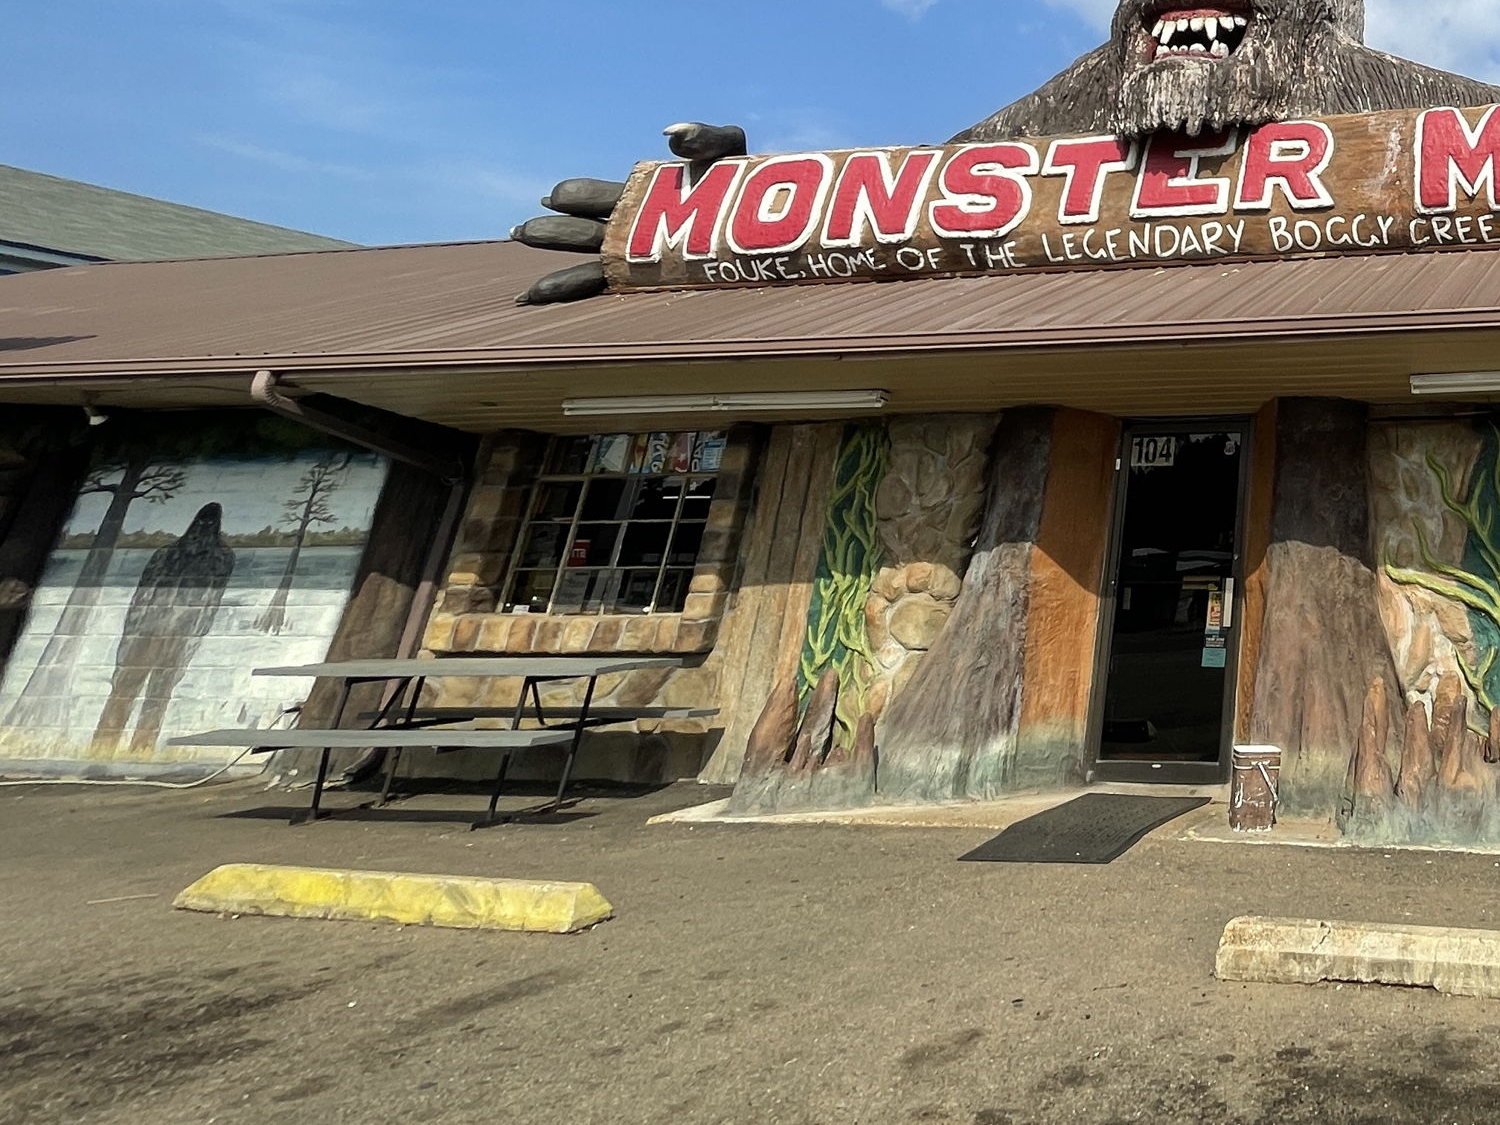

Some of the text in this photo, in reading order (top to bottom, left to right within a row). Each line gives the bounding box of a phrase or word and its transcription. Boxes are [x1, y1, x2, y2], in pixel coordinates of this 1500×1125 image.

[625, 120, 1335, 264] MONSTER
[703, 256, 806, 284] FOUKE,
[807, 248, 887, 277] HOME
[896, 247, 944, 271] OF
[960, 240, 1027, 268] THE
[1042, 218, 1245, 262] LEGENDARY
[1269, 213, 1394, 252] BOGGY
[1133, 437, 1172, 464] 104
